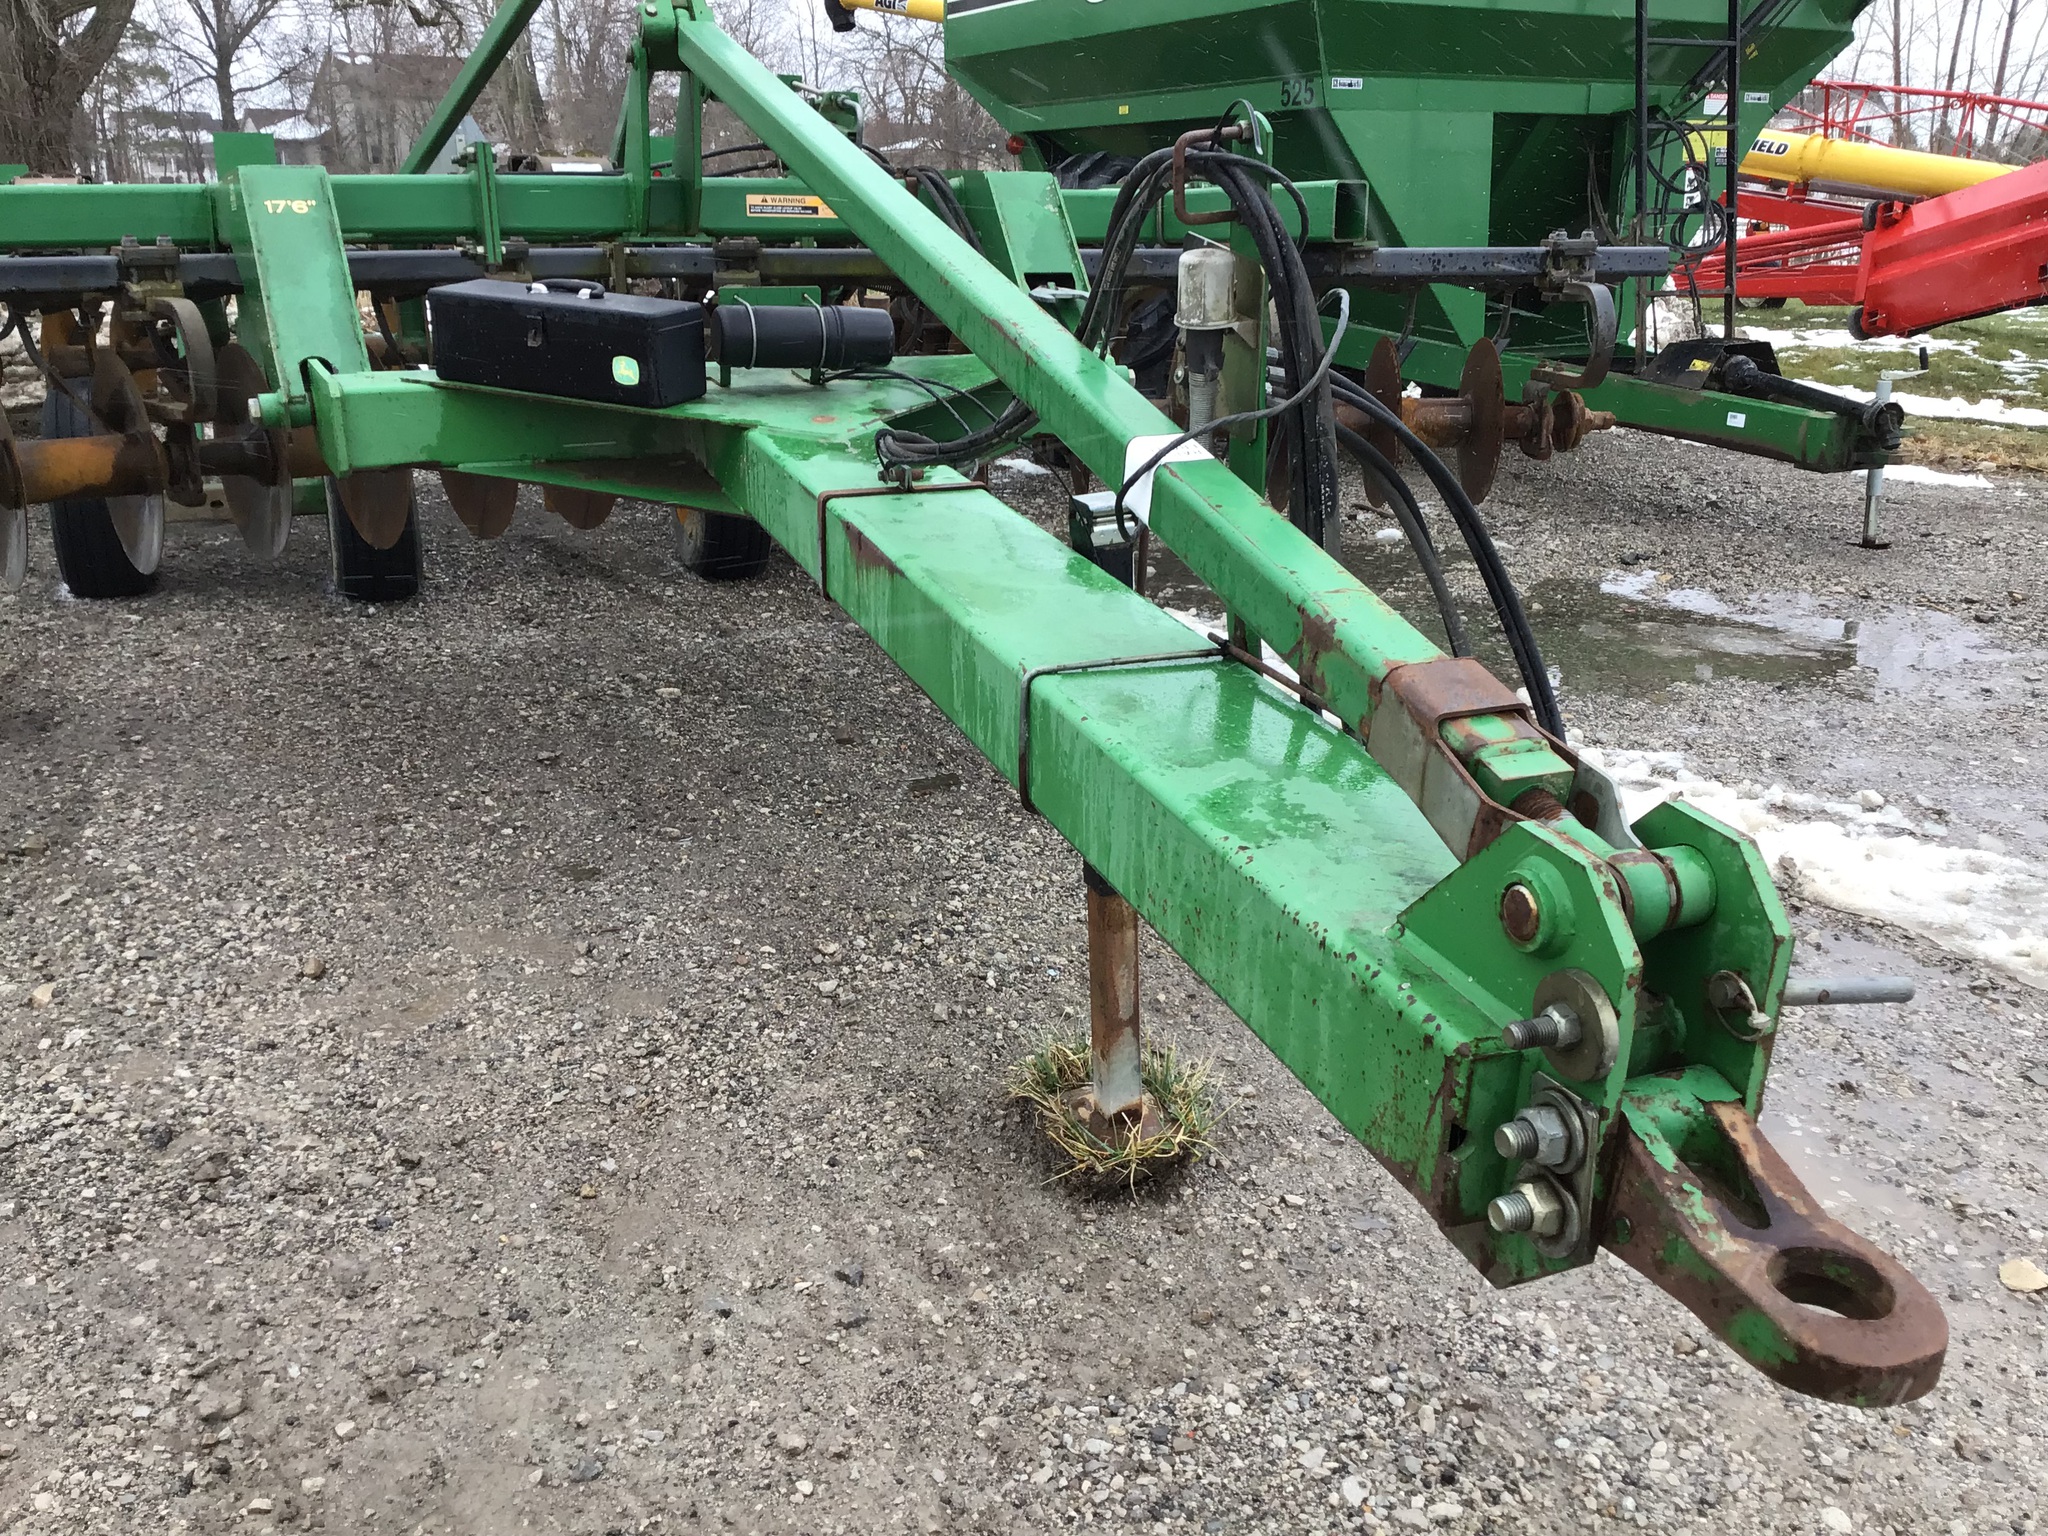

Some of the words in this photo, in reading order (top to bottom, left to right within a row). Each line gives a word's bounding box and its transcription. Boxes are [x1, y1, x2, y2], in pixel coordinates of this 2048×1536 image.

[874, 0, 896, 9] AGI
[1280, 77, 1315, 107] 525
[770, 196, 807, 204] WARNING
[263, 199, 317, 214] 17'6"
